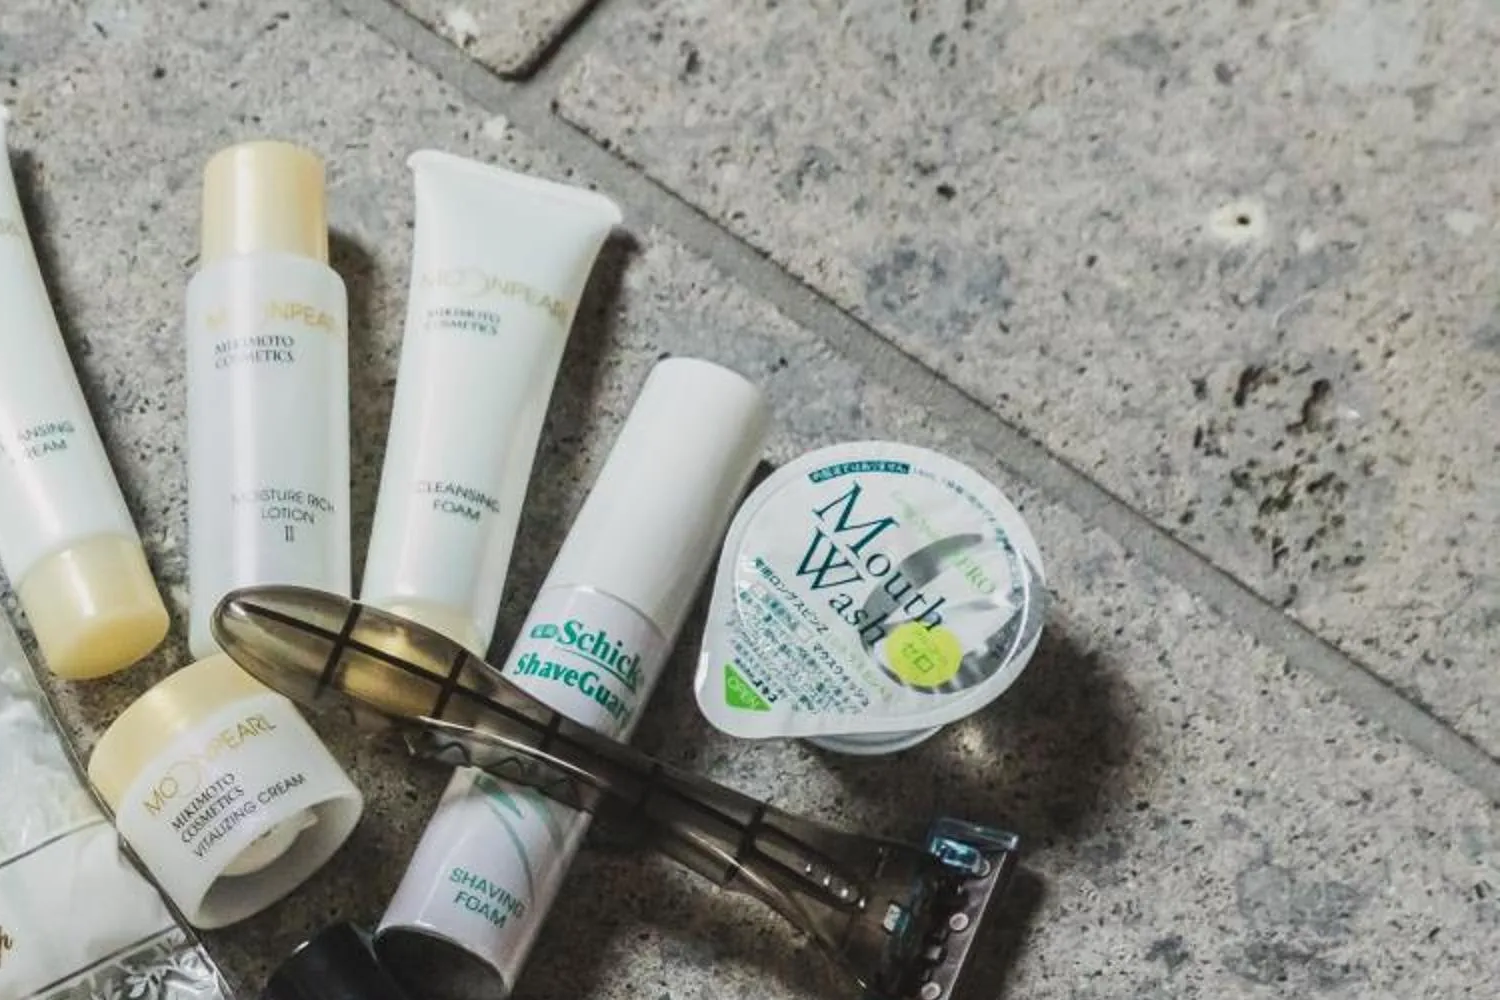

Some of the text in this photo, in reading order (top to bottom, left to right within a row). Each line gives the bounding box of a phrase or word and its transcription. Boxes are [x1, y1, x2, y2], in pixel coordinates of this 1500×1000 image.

[260, 505, 316, 525] LOTION
[432, 498, 482, 523] FOAM
[810, 480, 947, 633] Mouth
[795, 527, 890, 648] Wash
[556, 619, 645, 690] Schick
[170, 772, 236, 833] MIKIMOTO
[180, 786, 245, 844] COSMETICS
[193, 773, 307, 860] VITALIZING CREAM
[450, 867, 524, 919] SHAVING
[452, 891, 507, 930] FOAM
